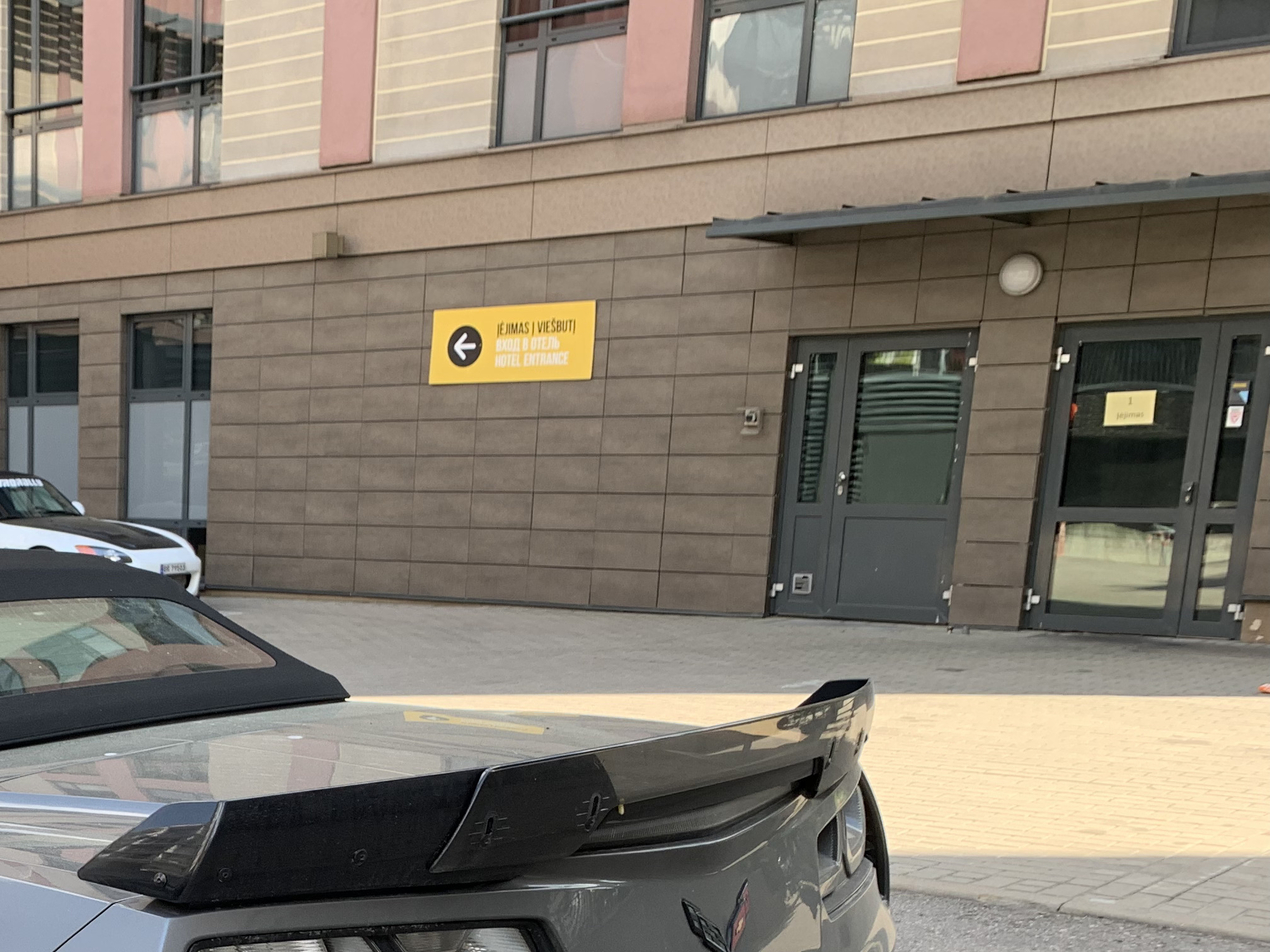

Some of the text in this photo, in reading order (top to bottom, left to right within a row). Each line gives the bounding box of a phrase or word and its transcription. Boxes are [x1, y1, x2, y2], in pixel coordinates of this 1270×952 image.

[537, 318, 576, 335] VIEŠBUTĮ
[496, 338, 521, 353] ВХОД
[530, 336, 561, 351] ОТЕЛЬ
[495, 351, 570, 368] HOTEL ENTRANCE
